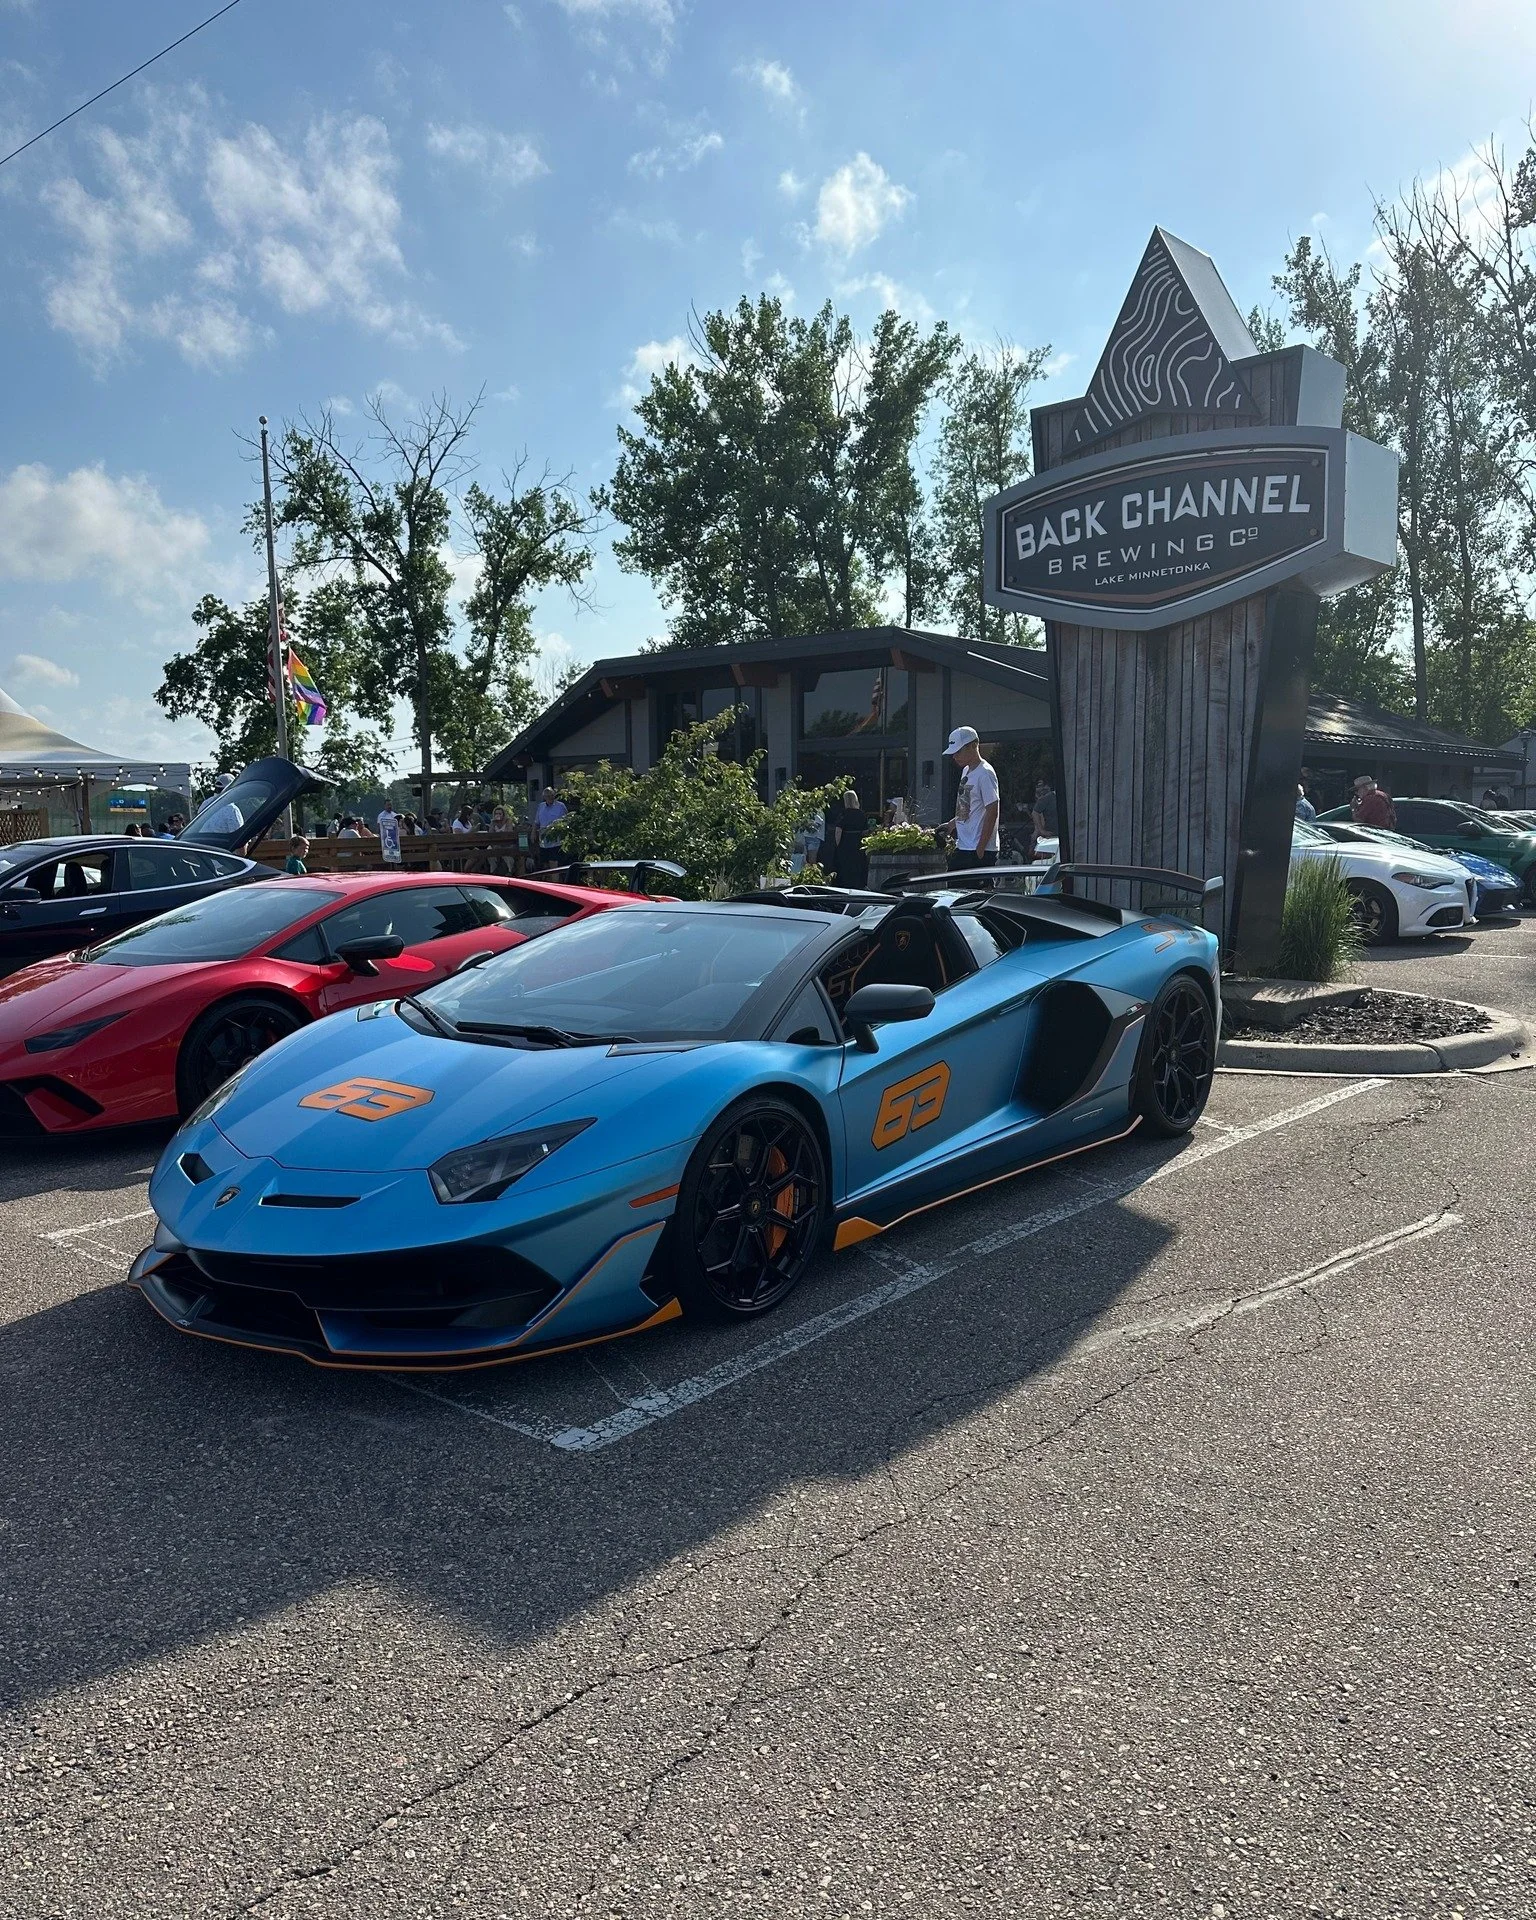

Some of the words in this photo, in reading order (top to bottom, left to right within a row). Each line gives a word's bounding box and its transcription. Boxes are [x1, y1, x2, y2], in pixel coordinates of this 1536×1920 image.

[1015, 500, 1108, 561] BACK
[1121, 474, 1311, 530] CHANNEL
[1048, 532, 1214, 576] BREWING
[1095, 573, 1125, 586] LAKE
[1129, 562, 1211, 581] MINNETONKA
[297, 1076, 435, 1122] 63
[871, 1060, 951, 1152] 63
